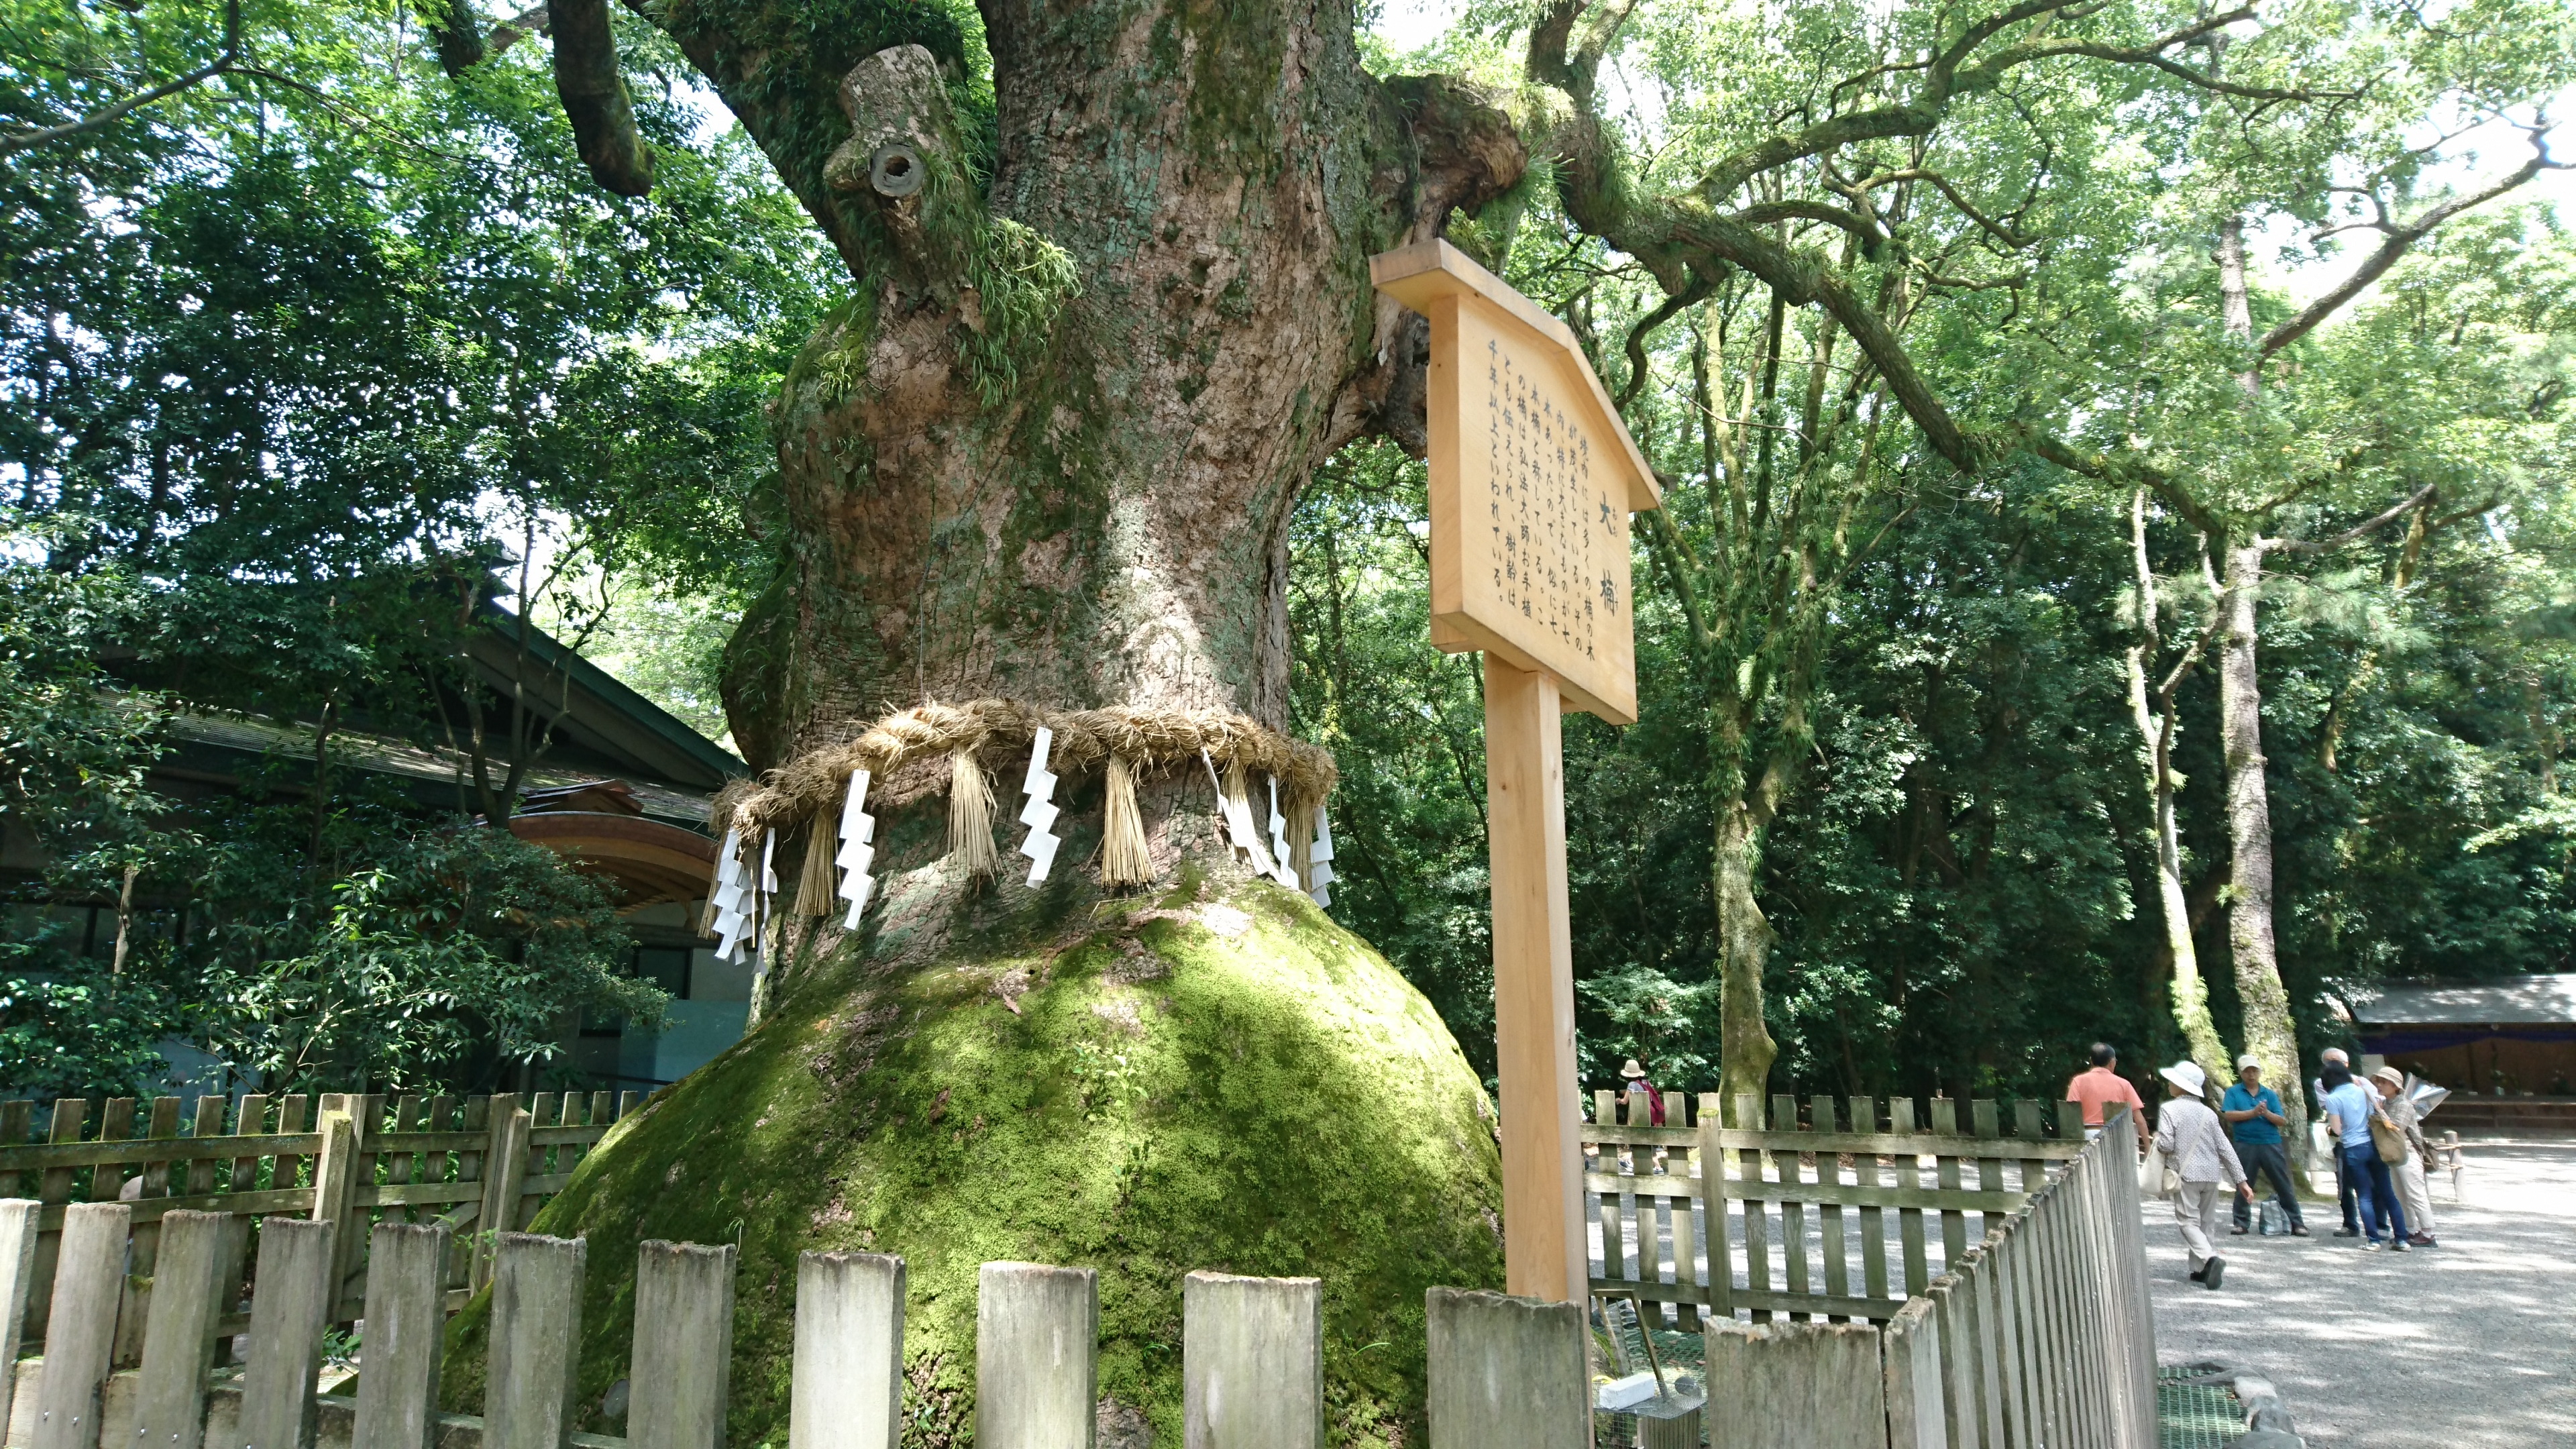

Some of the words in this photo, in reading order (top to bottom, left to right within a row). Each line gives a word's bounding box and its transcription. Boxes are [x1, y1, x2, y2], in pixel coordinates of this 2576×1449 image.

[1488, 338, 1503, 602] 千年以上といわれている。
[1503, 356, 1517, 608] とも伝えられ、樹齢は
[1517, 374, 1532, 619] の楠は弘法大師お手植
[1531, 382, 1544, 625] 本楠と称している。こ
[1544, 396, 1557, 635] 本あったので、俗に七
[1556, 410, 1570, 644] 内、特に大きなものが七
[1580, 434, 1595, 661] 境内には多くの楠の木
